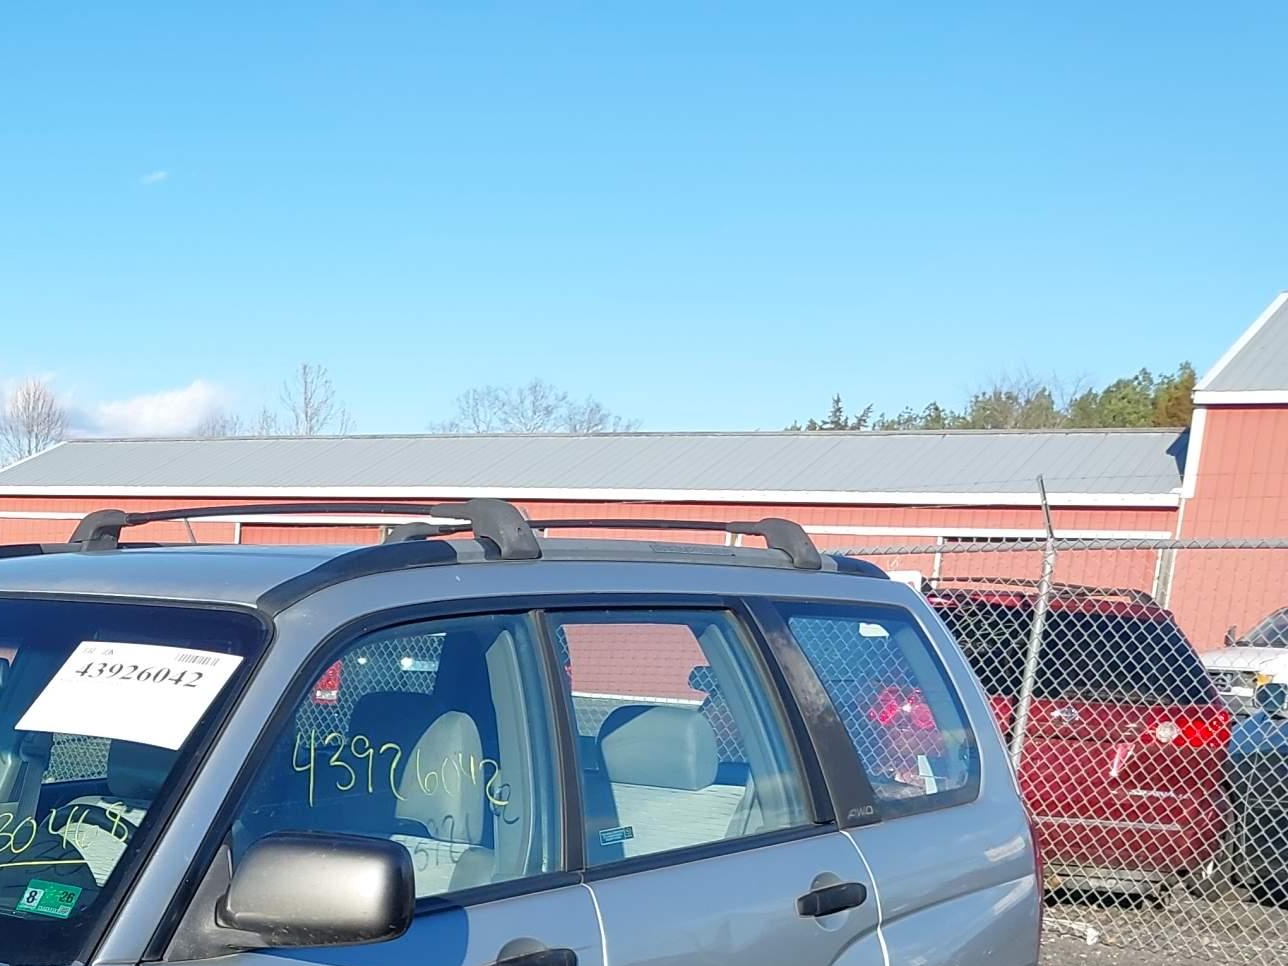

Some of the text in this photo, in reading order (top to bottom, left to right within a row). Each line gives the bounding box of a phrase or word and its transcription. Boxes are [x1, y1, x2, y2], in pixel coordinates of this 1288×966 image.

[75, 661, 203, 688] 43926042
[293, 730, 509, 807] 43926042
[26, 890, 75, 903] 8 26
